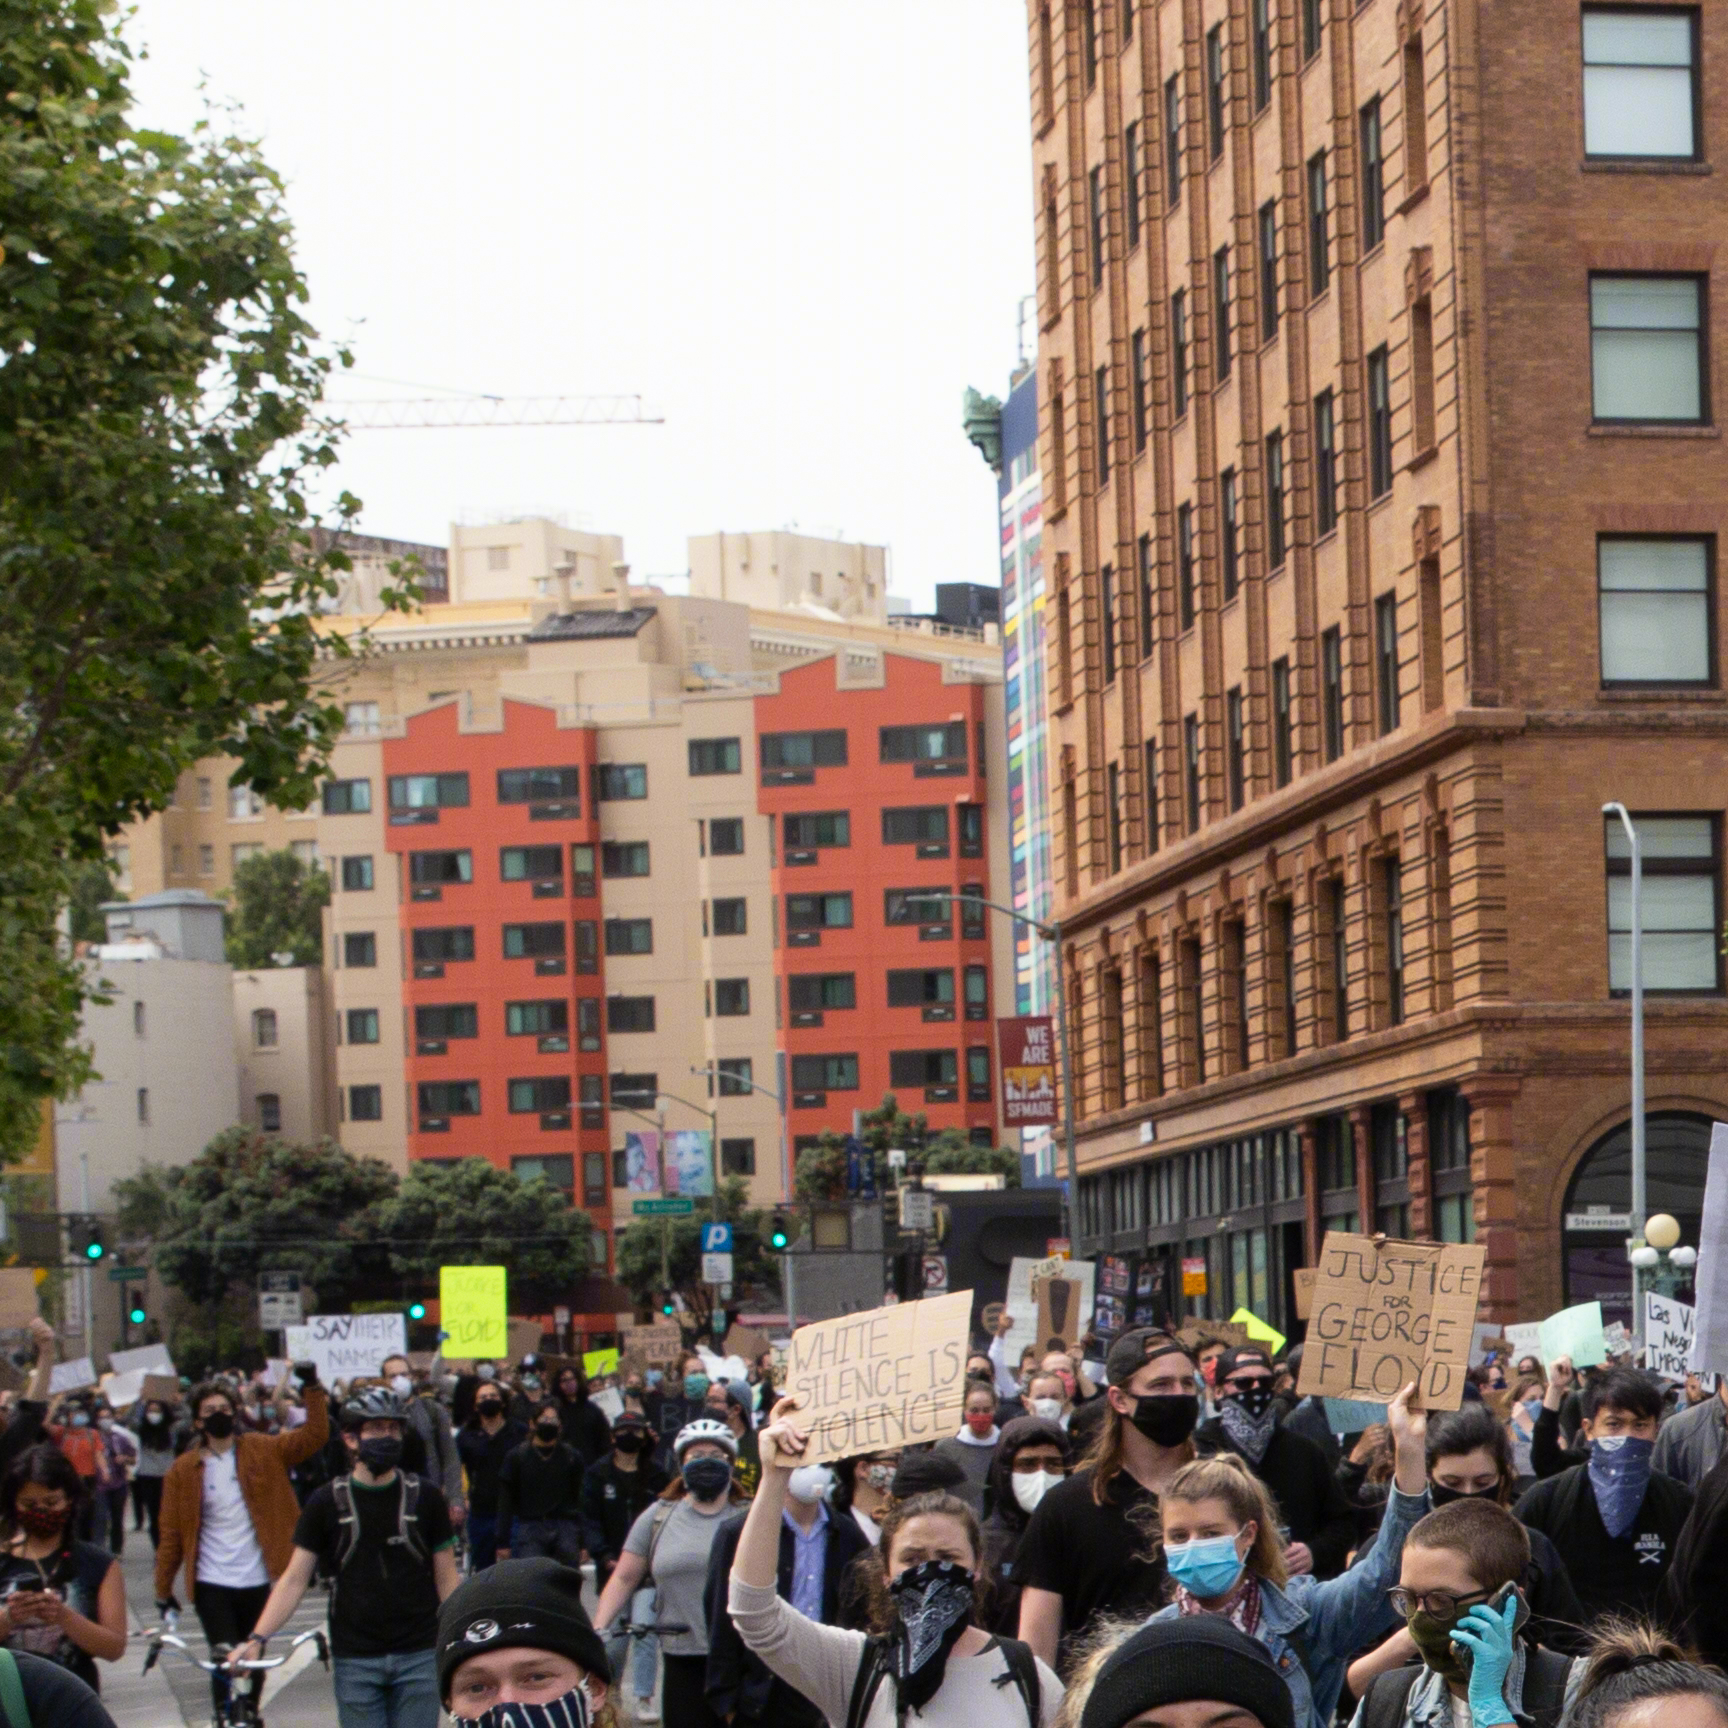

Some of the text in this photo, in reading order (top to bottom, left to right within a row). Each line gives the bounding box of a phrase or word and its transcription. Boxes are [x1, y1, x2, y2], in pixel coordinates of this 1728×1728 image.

[1025, 1025, 1049, 1044] WE
[1022, 1046, 1050, 1064] ARE
[1006, 1100, 1055, 1118] SFMADE
[1574, 1217, 1628, 1227] Stevenson
[1327, 1249, 1477, 1295] JUSTICE
[1382, 1295, 1414, 1310] FOR
[313, 1316, 353, 1341] SAY
[1316, 1302, 1457, 1354] GEORGE
[793, 1316, 890, 1374] WHITE
[795, 1354, 915, 1412] SILENCE
[929, 1341, 960, 1390] IS
[1318, 1342, 1451, 1399] FLOYD
